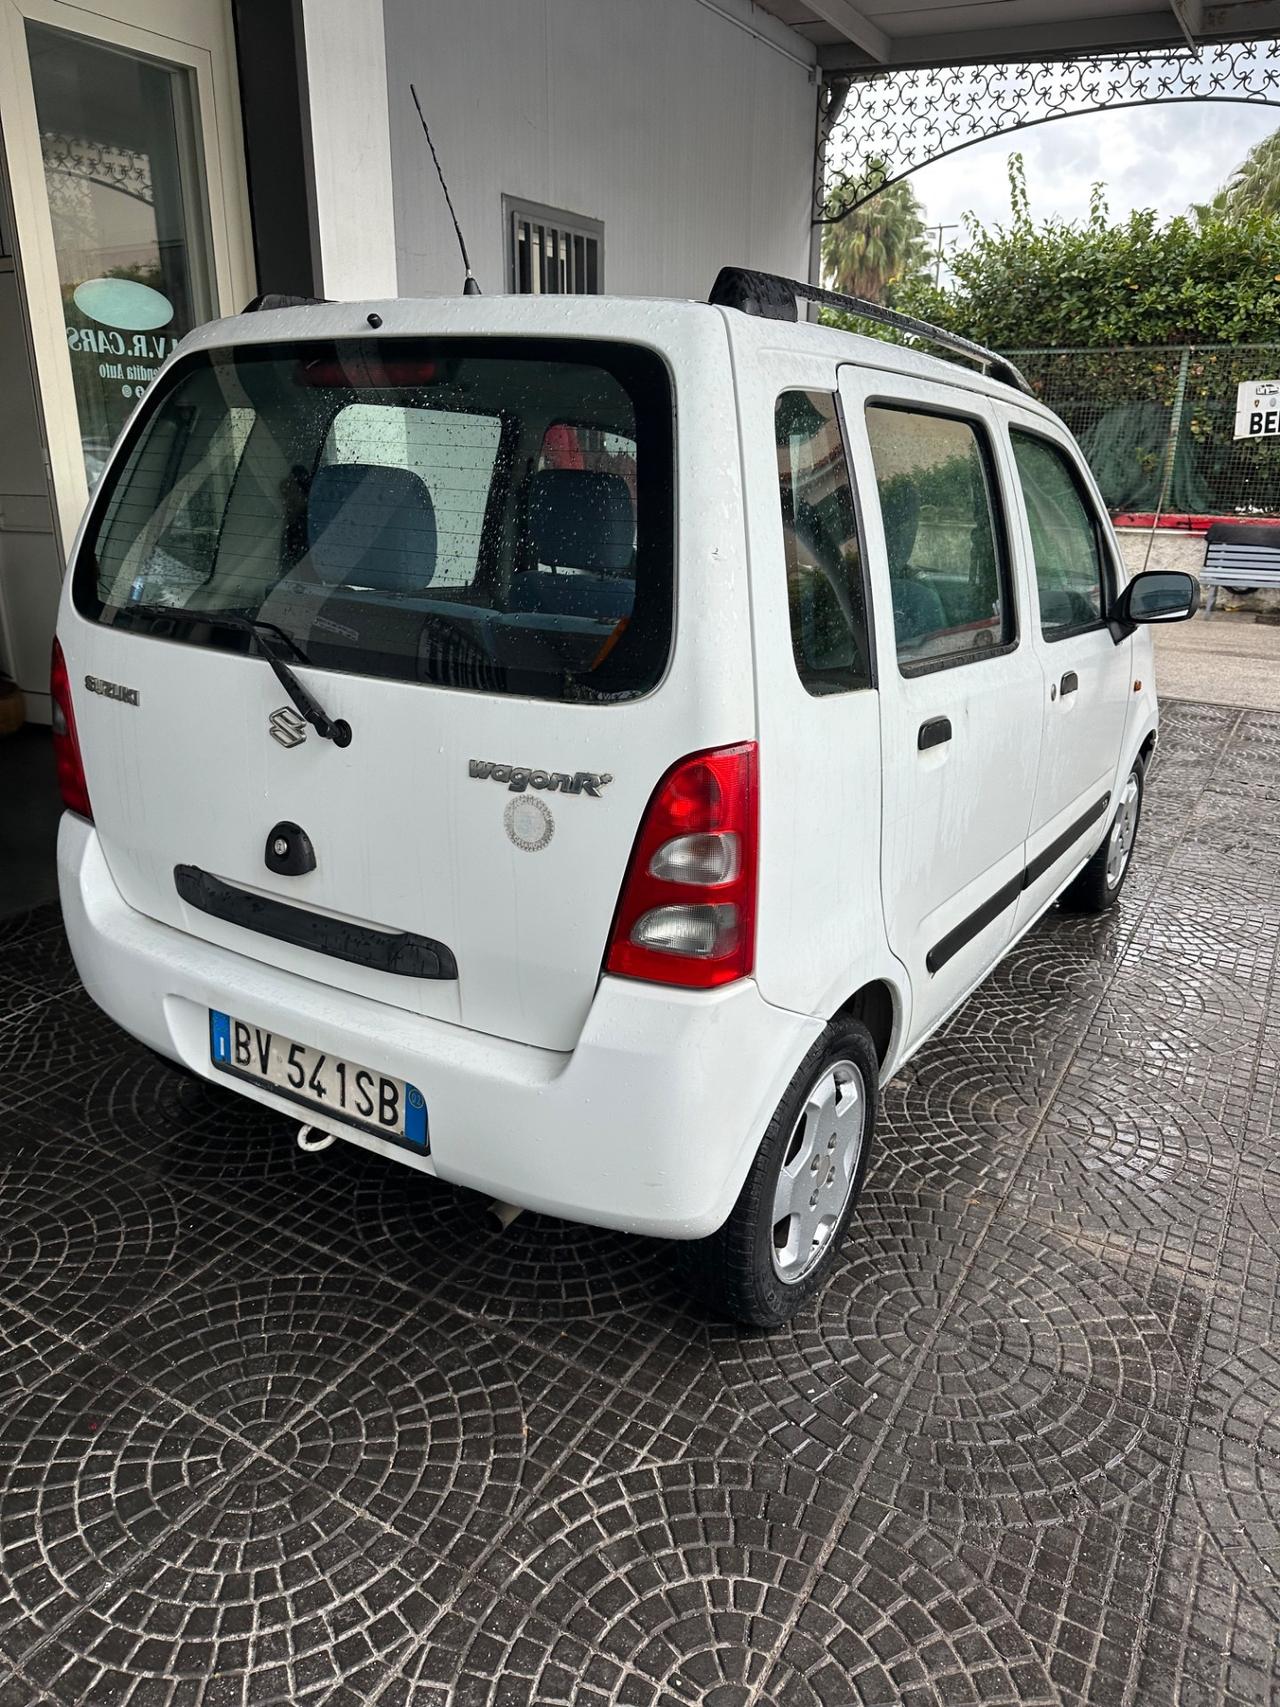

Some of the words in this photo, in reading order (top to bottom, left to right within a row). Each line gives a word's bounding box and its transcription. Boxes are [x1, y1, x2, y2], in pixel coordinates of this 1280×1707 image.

[1249, 411, 1280, 435] BE
[84, 674, 140, 707] SUZUKI
[234, 1021, 272, 1075] BV
[287, 1043, 400, 1126] 541SB
